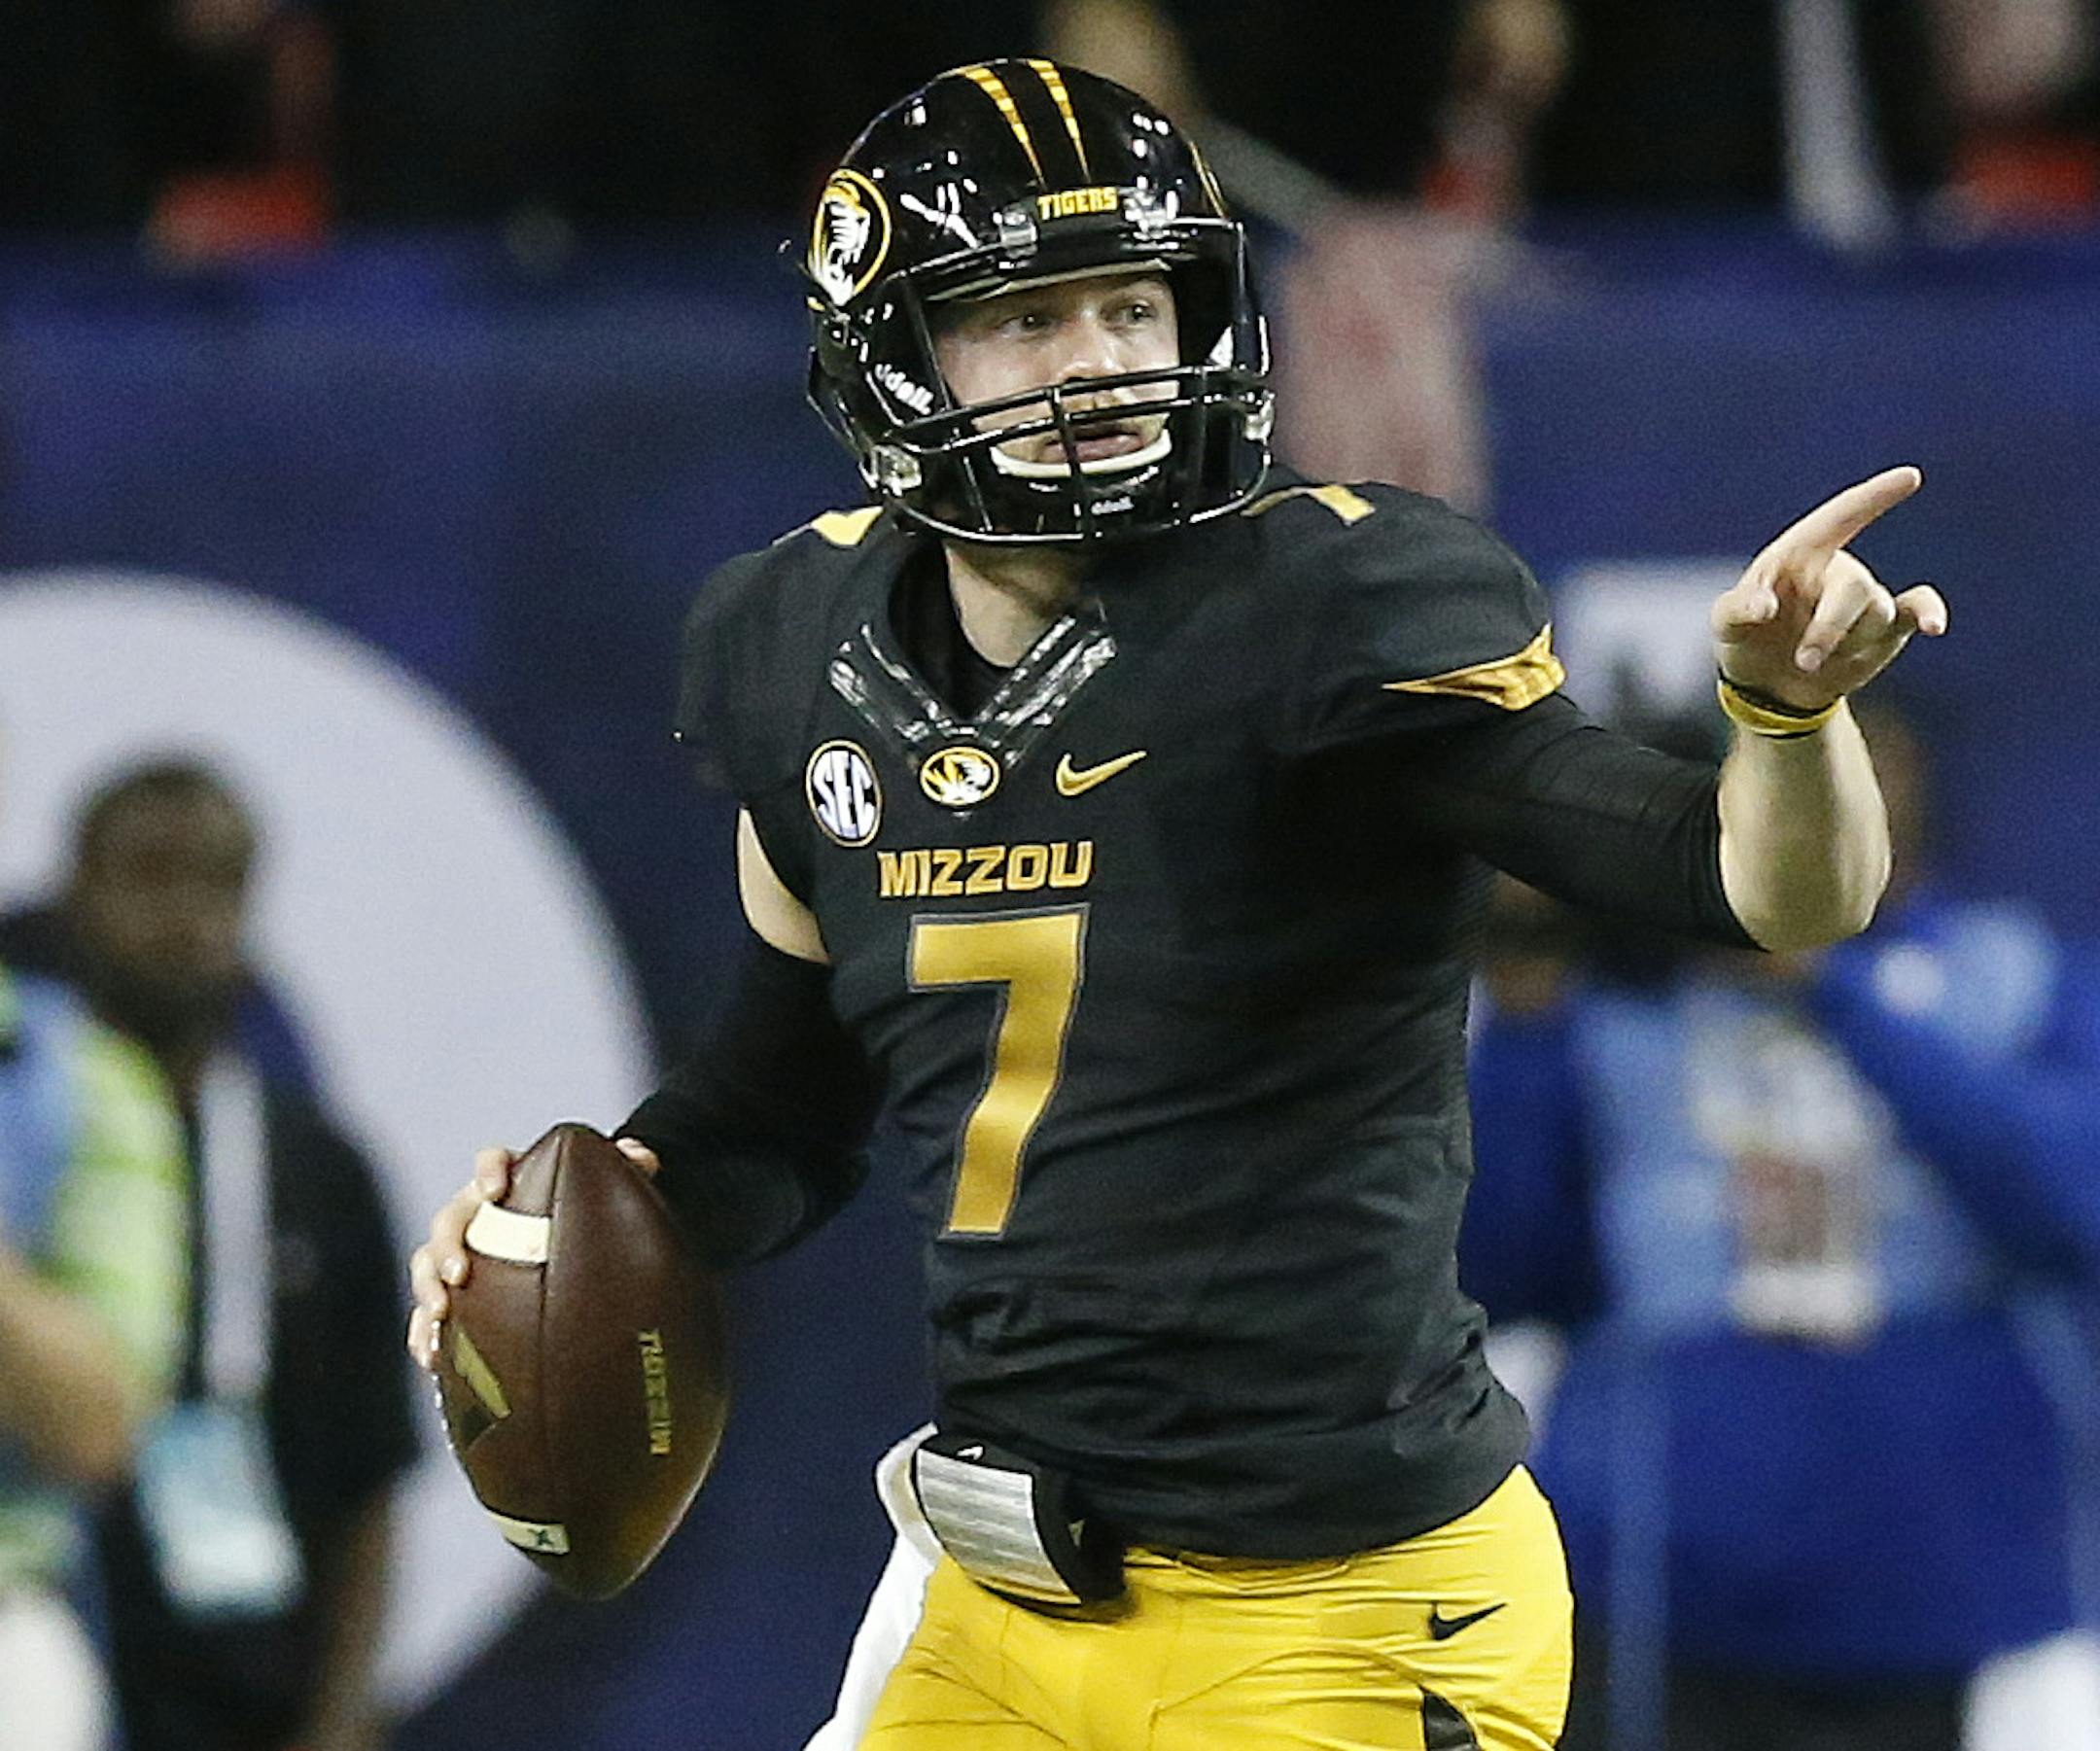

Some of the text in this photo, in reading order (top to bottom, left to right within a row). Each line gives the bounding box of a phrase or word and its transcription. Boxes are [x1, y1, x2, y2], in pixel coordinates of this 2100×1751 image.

[1036, 187, 1118, 220] TIGERS
[813, 751, 874, 839] SEC
[877, 840, 1094, 898] MIZZOU
[907, 902, 1091, 1242] 7
